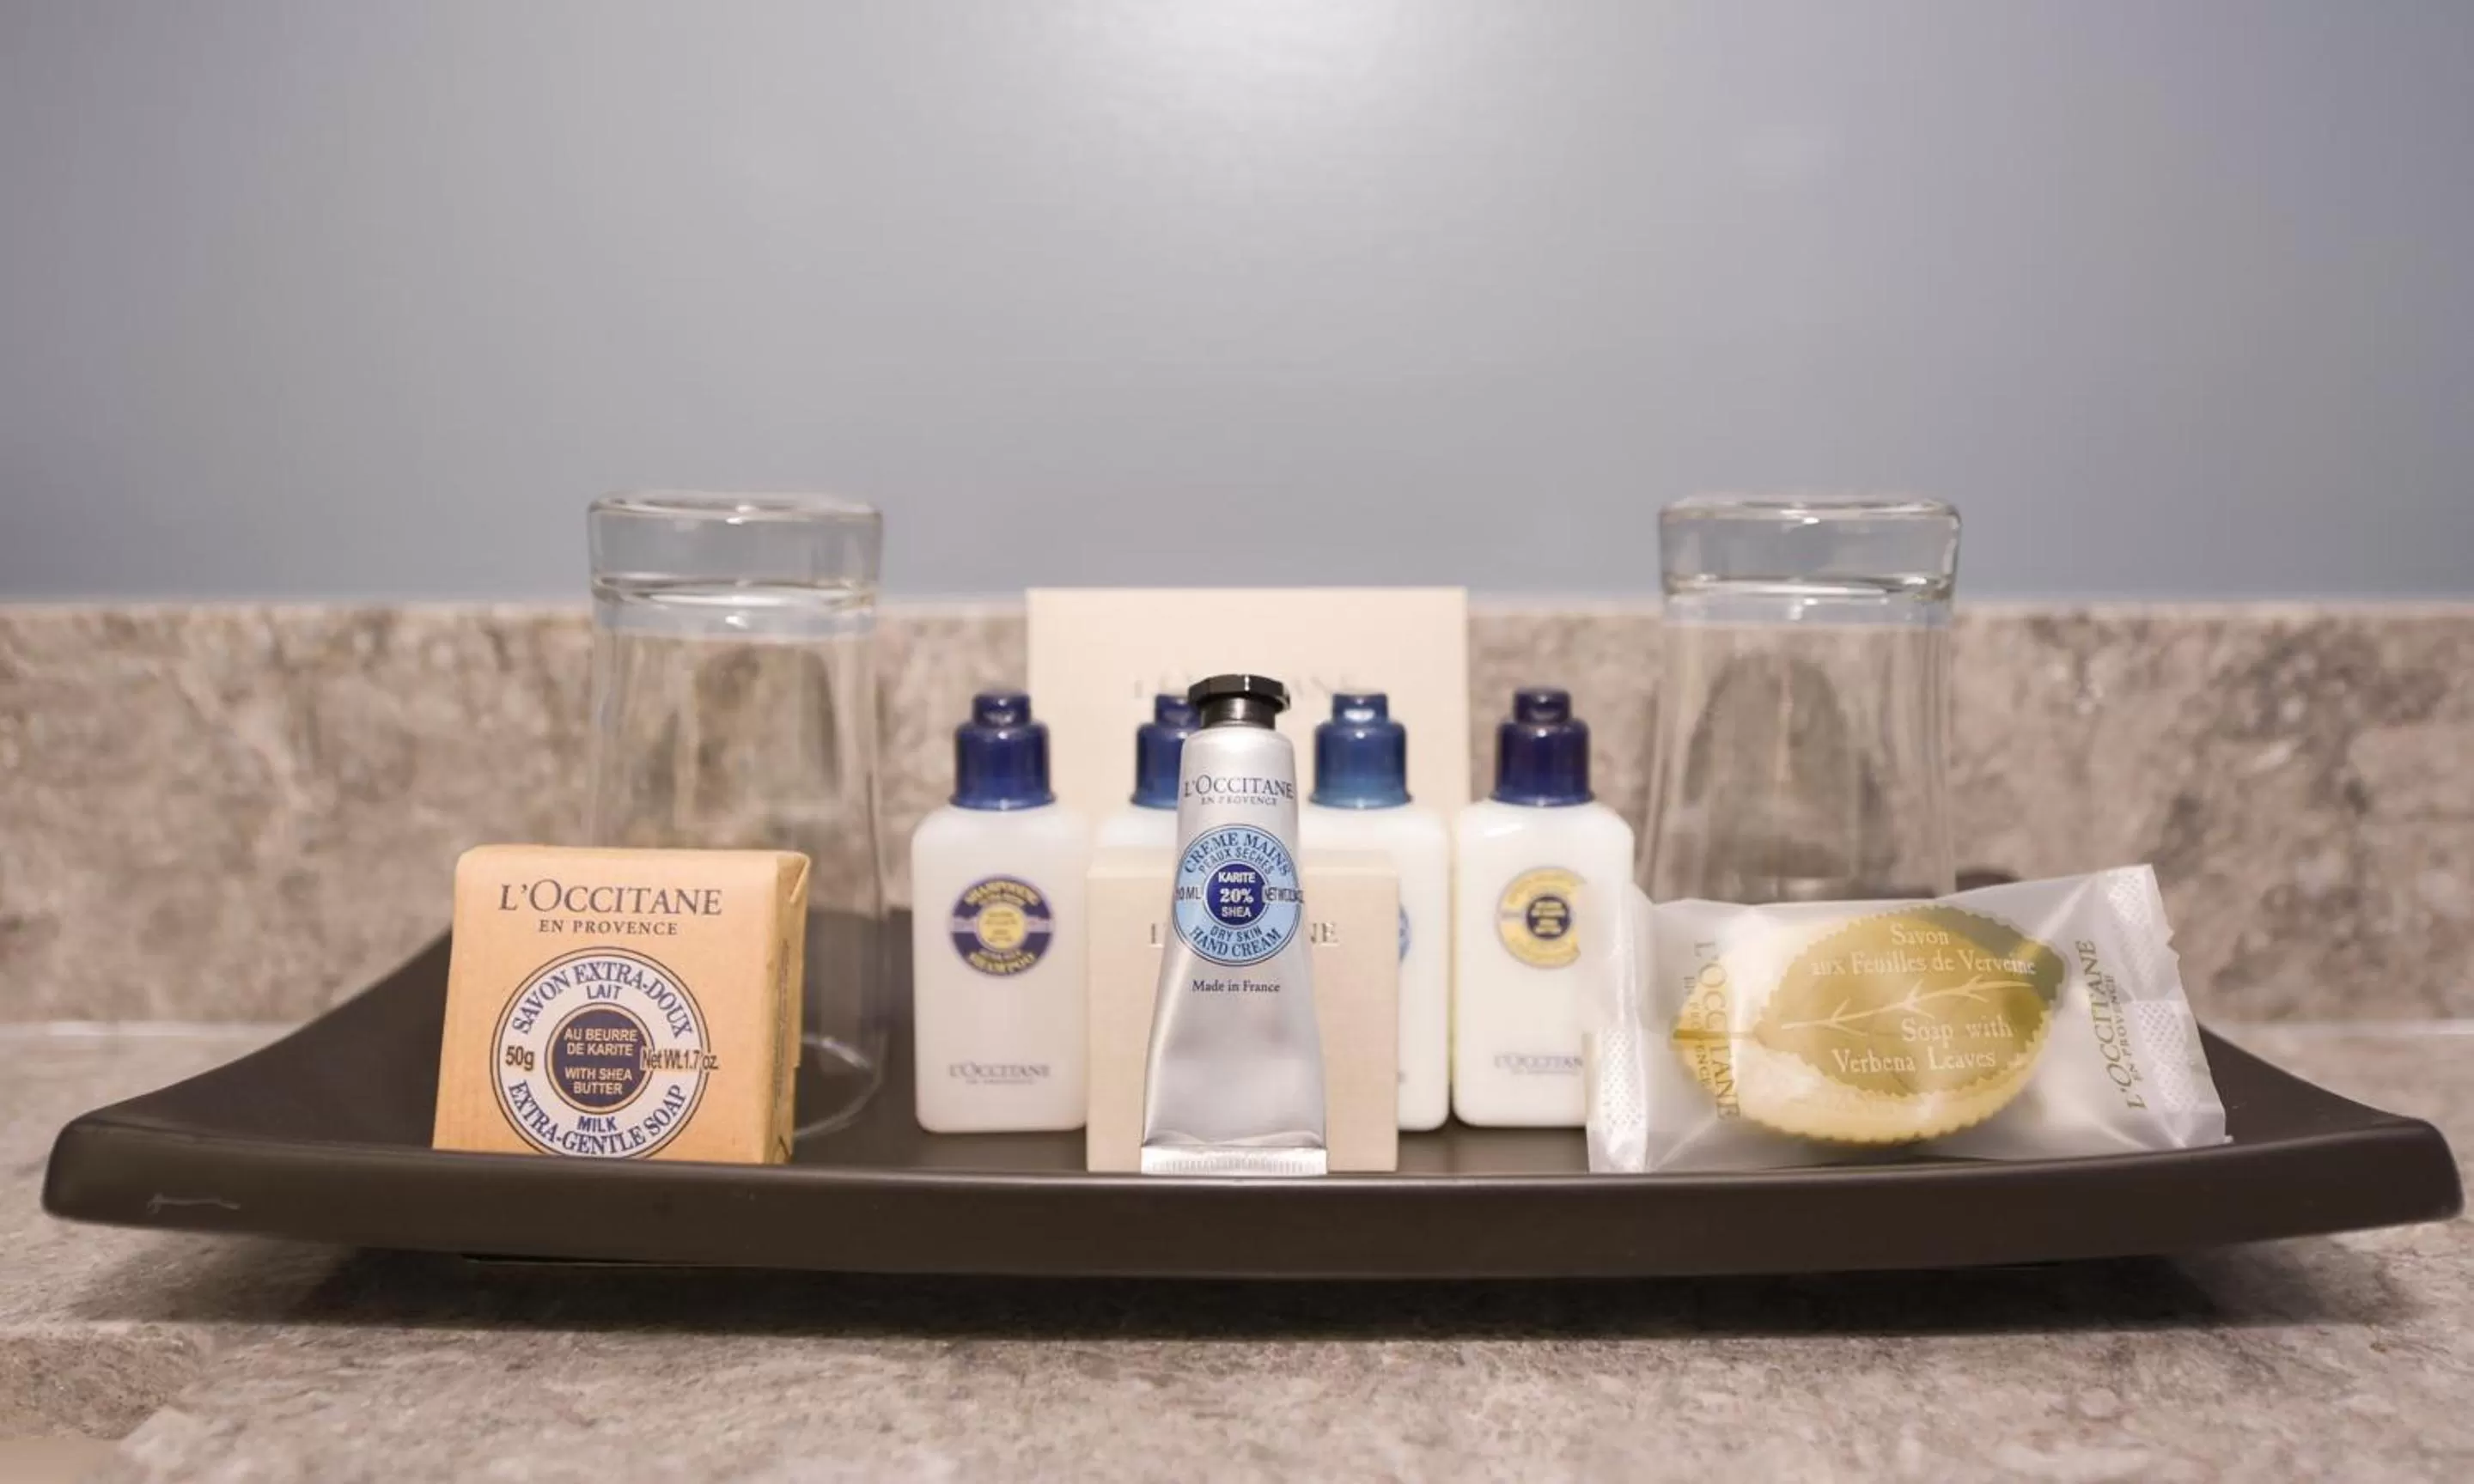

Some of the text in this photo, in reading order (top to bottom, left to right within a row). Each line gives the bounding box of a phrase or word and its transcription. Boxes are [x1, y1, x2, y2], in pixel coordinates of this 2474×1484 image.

[1185, 775, 1295, 800] L'OCCITANE
[1185, 832, 1292, 876] CREME MAINS
[1199, 847, 1275, 874] PEAUX SECHES
[1218, 872, 1256, 883] KARITE
[498, 879, 723, 915] L'OCCITANE
[1220, 888, 1254, 903] 20%
[1221, 907, 1252, 918] SHEA
[539, 919, 679, 936] EN PROVENCE
[1210, 925, 1262, 942] DRY SKIN
[1890, 923, 1950, 946] Savon
[1189, 926, 1228, 956] HAND
[1231, 928, 1282, 957] CREAM
[1812, 949, 2037, 976] aux Feuilles de Verveine
[587, 984, 623, 1000] LAIT
[1192, 980, 1281, 992] Made in France
[513, 969, 570, 1035] SAVON
[573, 960, 693, 1039] EXTRA-DOUX
[564, 1029, 638, 1042] AU BEURRE
[1901, 1014, 2015, 1050] Soap with
[2075, 940, 2148, 1110] L'OCCITANE
[505, 1046, 535, 1072] 50g
[567, 1043, 634, 1056] DE KARITE
[643, 1048, 661, 1070] Net
[1831, 1046, 1996, 1073] Verbena Leaves
[565, 1067, 633, 1081] WITH SHEA
[574, 1082, 624, 1095] BUTTER
[508, 1079, 687, 1156] EXTRA-GENTLE SOAP
[576, 1116, 617, 1134] MILK
